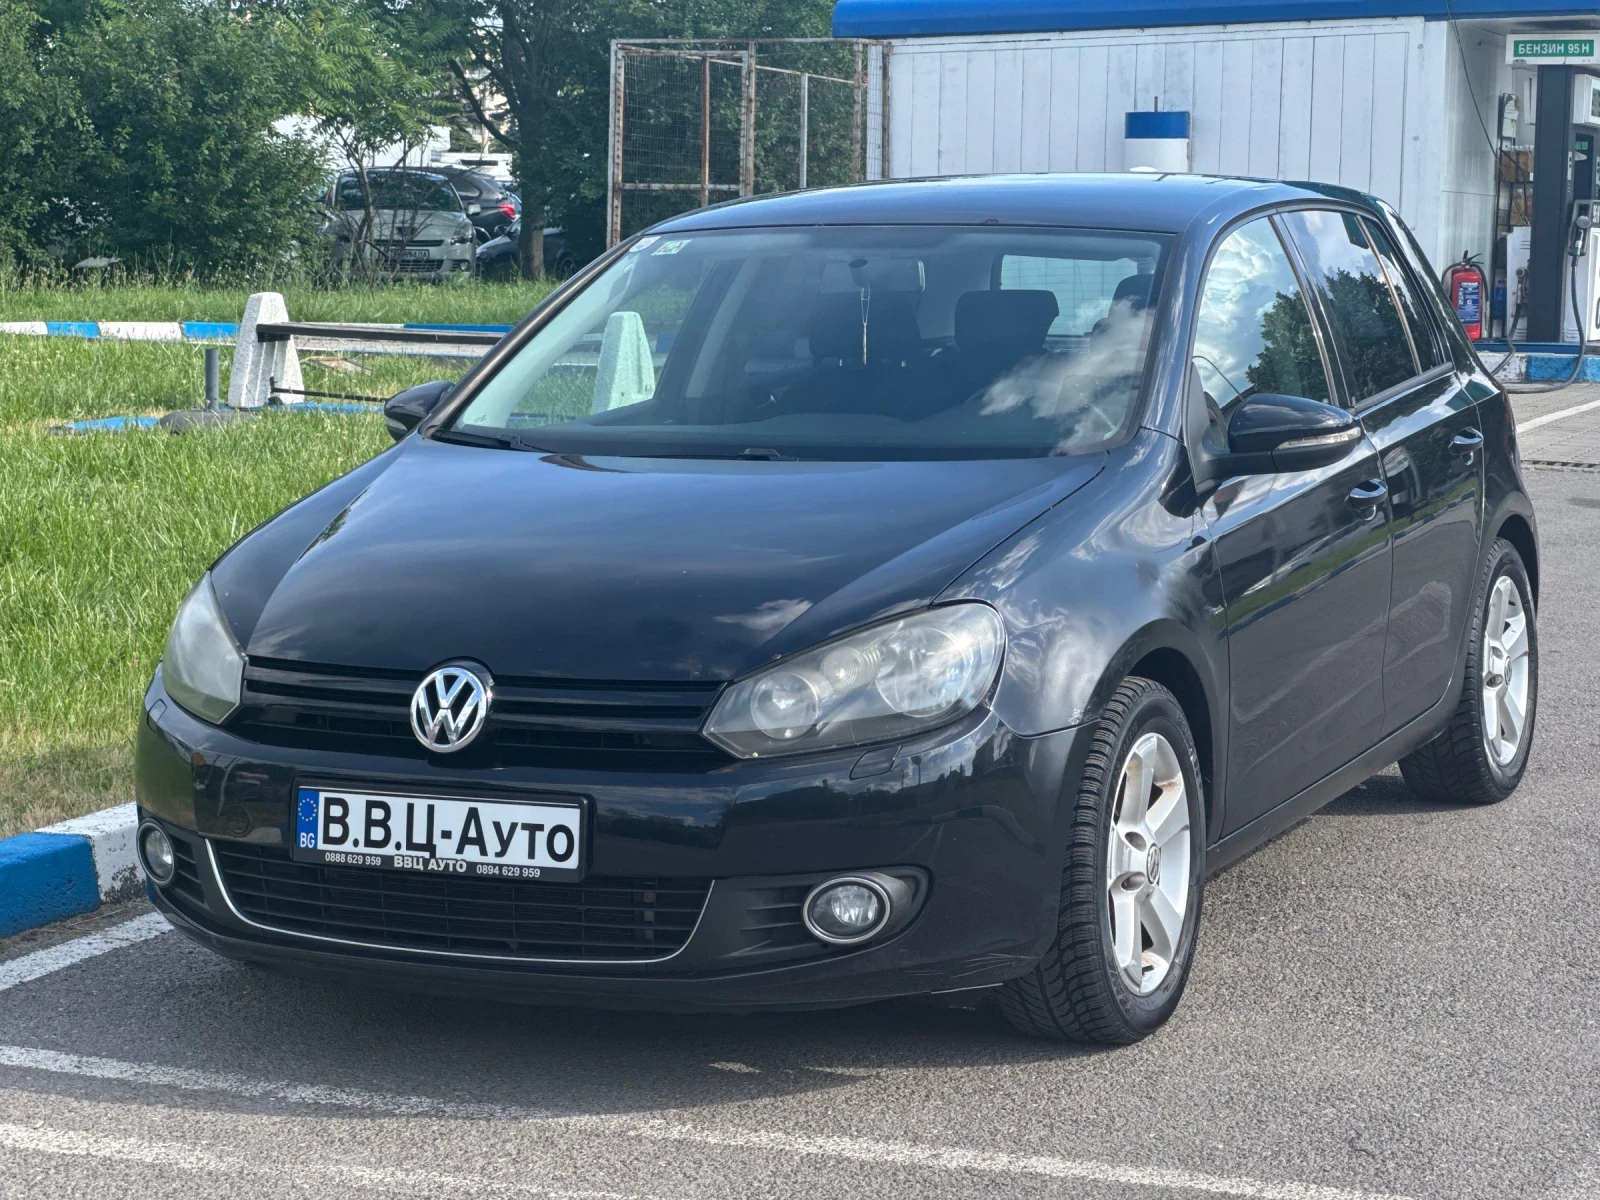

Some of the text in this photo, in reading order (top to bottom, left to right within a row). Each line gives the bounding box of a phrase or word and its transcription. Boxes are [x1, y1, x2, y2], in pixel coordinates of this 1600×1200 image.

[1518, 43, 1564, 54] БЕНЗИН
[412, 669, 484, 750] VW
[300, 832, 315, 848] BG
[322, 796, 575, 863] В.В.Ц-Ауто
[325, 852, 541, 878] 0888 629 959 ВВЦ АУТО 0894 629 959
